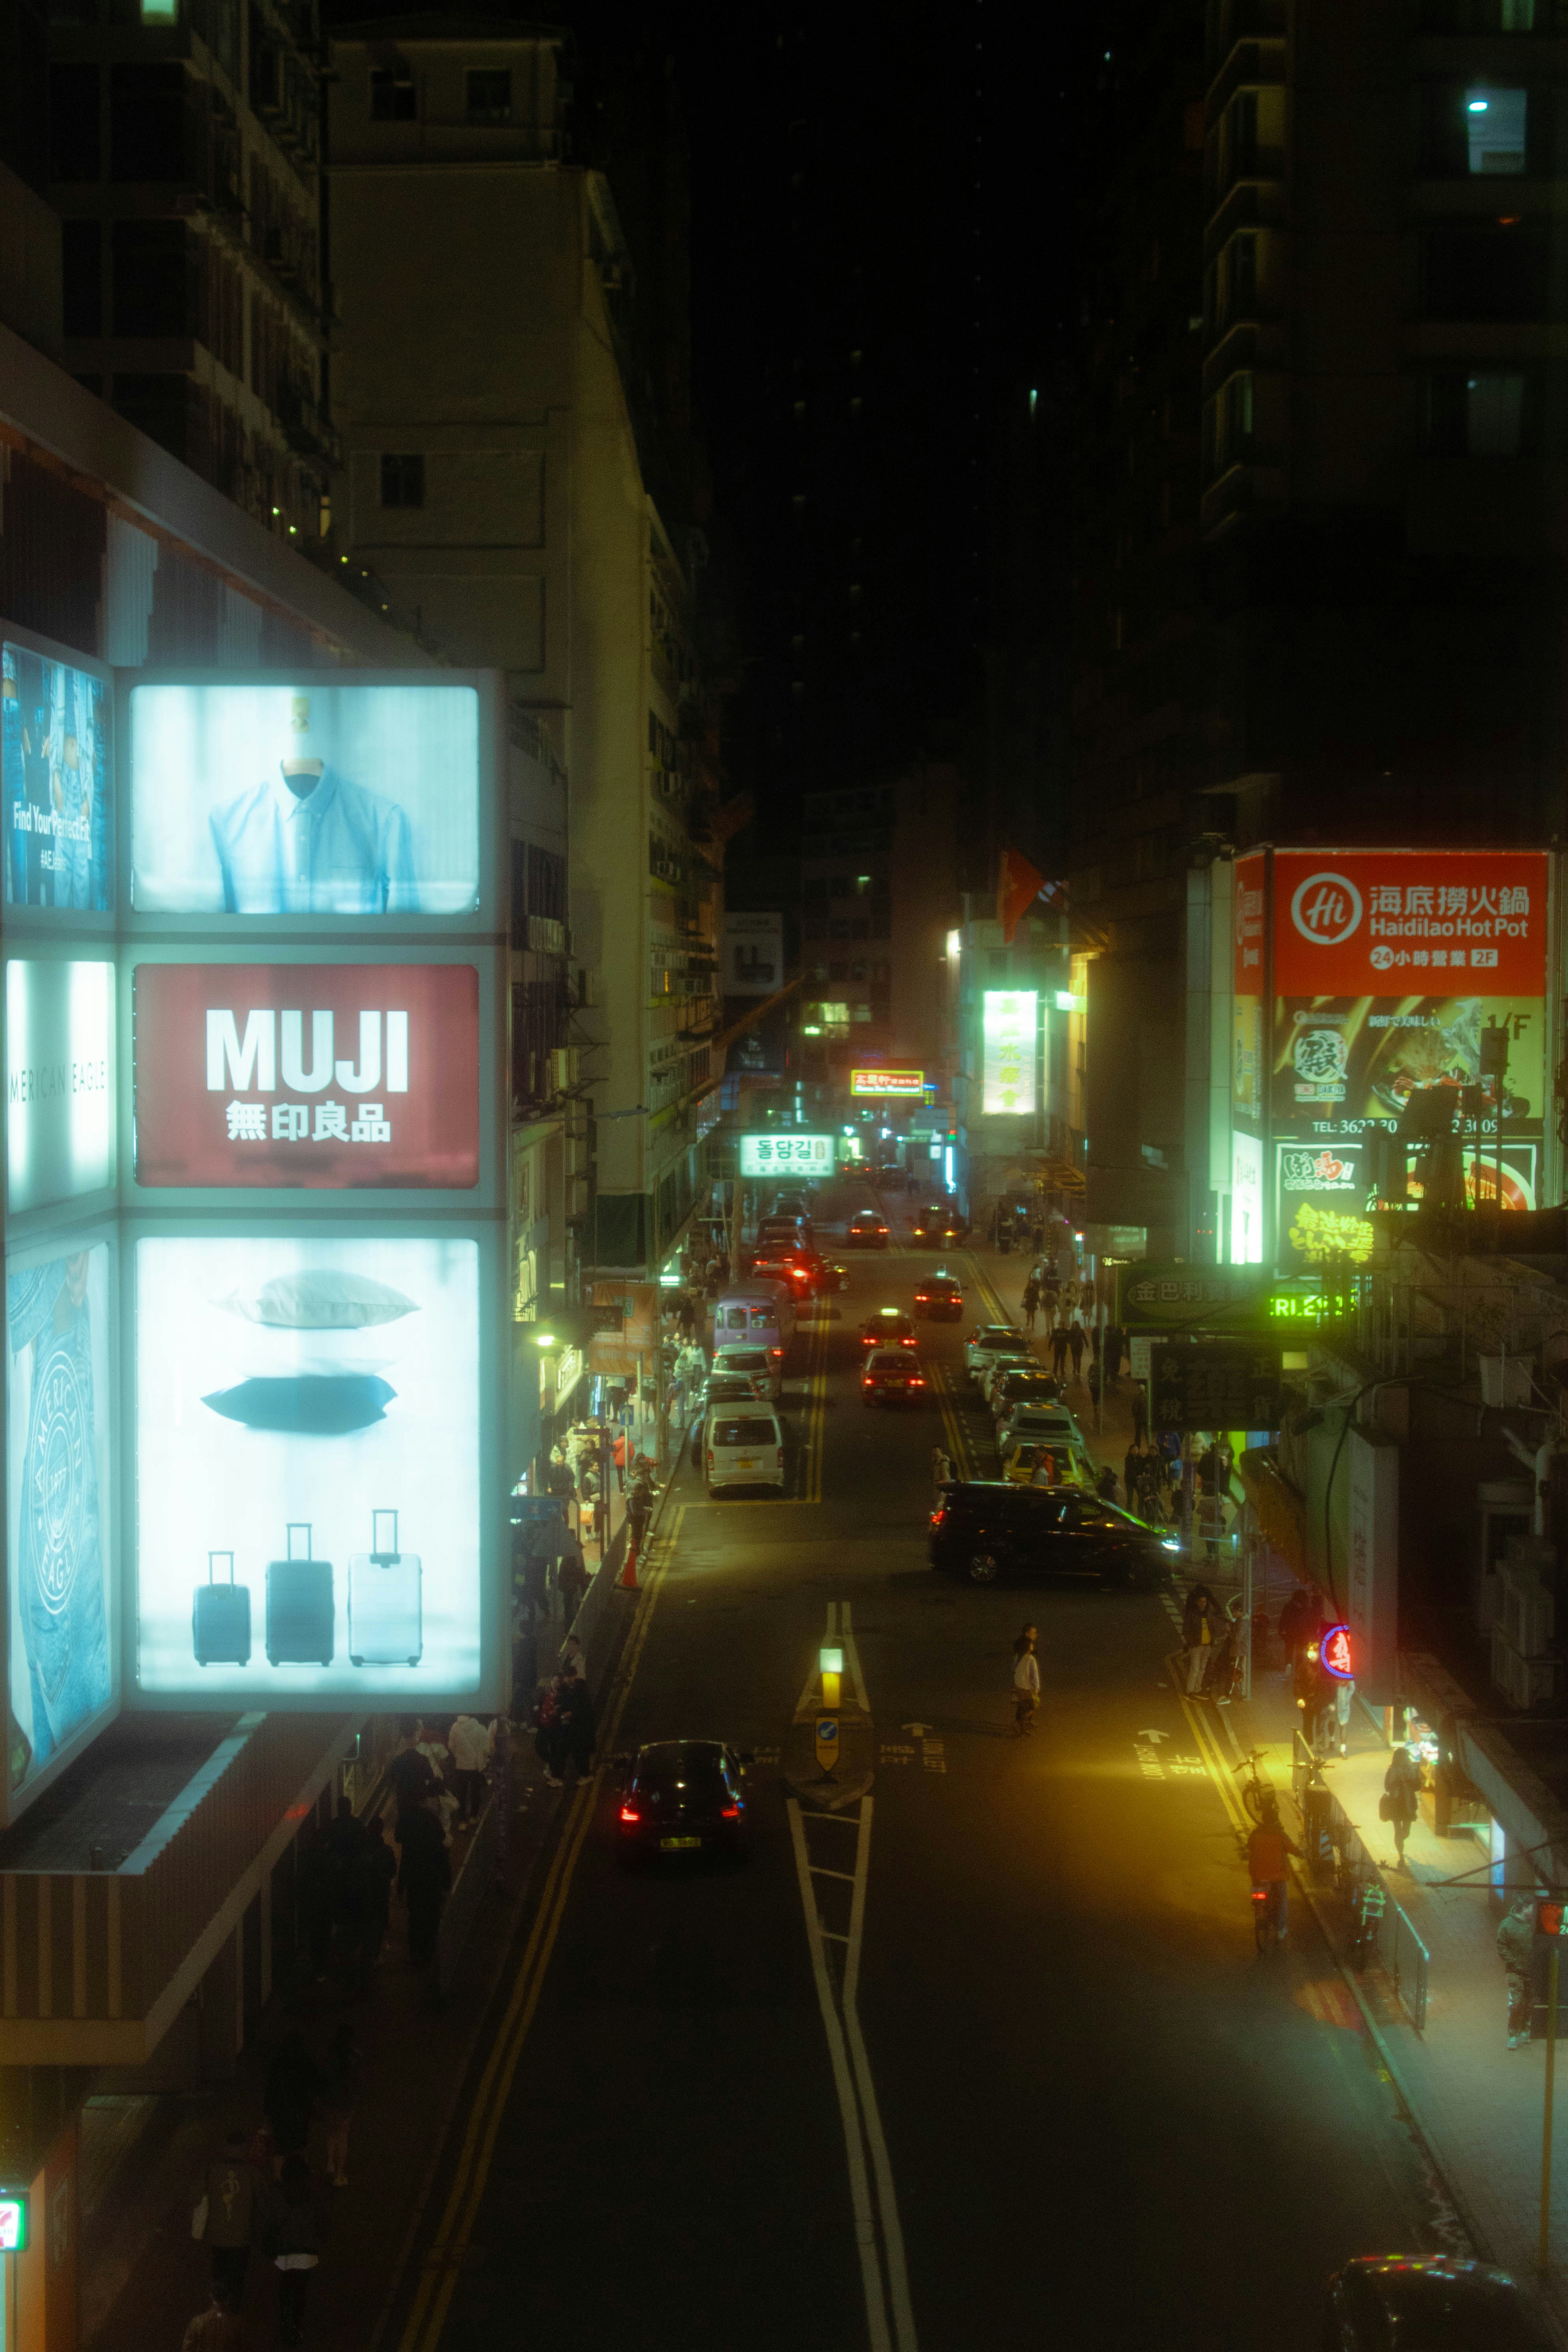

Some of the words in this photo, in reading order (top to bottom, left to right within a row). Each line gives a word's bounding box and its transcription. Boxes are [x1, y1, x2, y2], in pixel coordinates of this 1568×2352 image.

[14, 801, 32, 831] Find
[33, 805, 51, 835] Your
[52, 809, 79, 839] Perfect
[80, 815, 90, 842] Fit
[1370, 886, 1529, 916] 海底撈火鍋
[1370, 919, 1454, 938] Haidilao
[1457, 919, 1492, 938] Hot
[1495, 919, 1528, 938] Pot
[1476, 951, 1494, 965] 2F
[206, 1009, 408, 1093] MUJI
[73, 1061, 105, 1093] EAGLE
[225, 1100, 391, 1142] 無印良品
[1312, 1121, 1337, 1132] TEL:
[756, 1140, 811, 1159] 돌담길
[36, 1376, 82, 1492] AMERICAN
[50, 1467, 67, 1497] 1977
[42, 1526, 76, 1591] EAGLE
